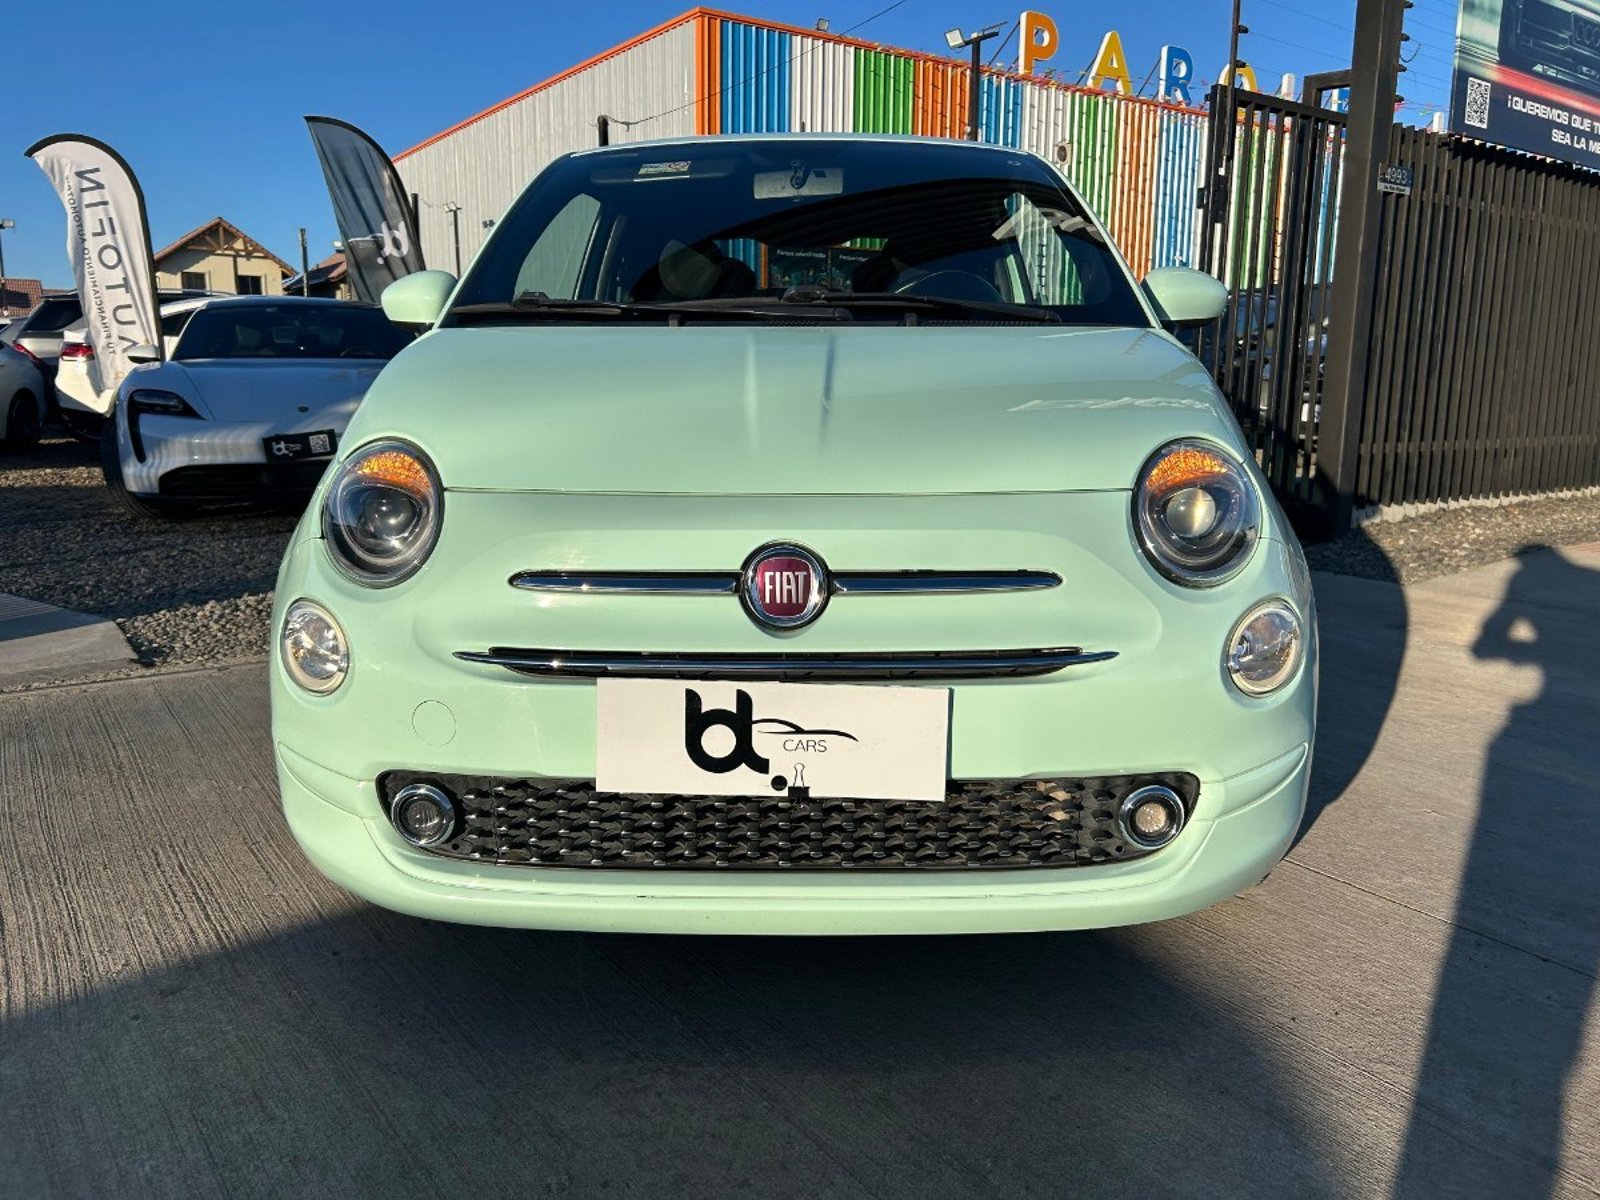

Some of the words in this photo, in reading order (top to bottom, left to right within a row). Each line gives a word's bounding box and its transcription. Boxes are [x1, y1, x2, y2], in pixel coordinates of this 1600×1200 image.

[1572, 114, 1591, 131] QUE
[1552, 128, 1571, 145] SEA
[1573, 135, 1586, 150] LA
[764, 571, 808, 604] FIAT
[782, 739, 828, 753] CARS
